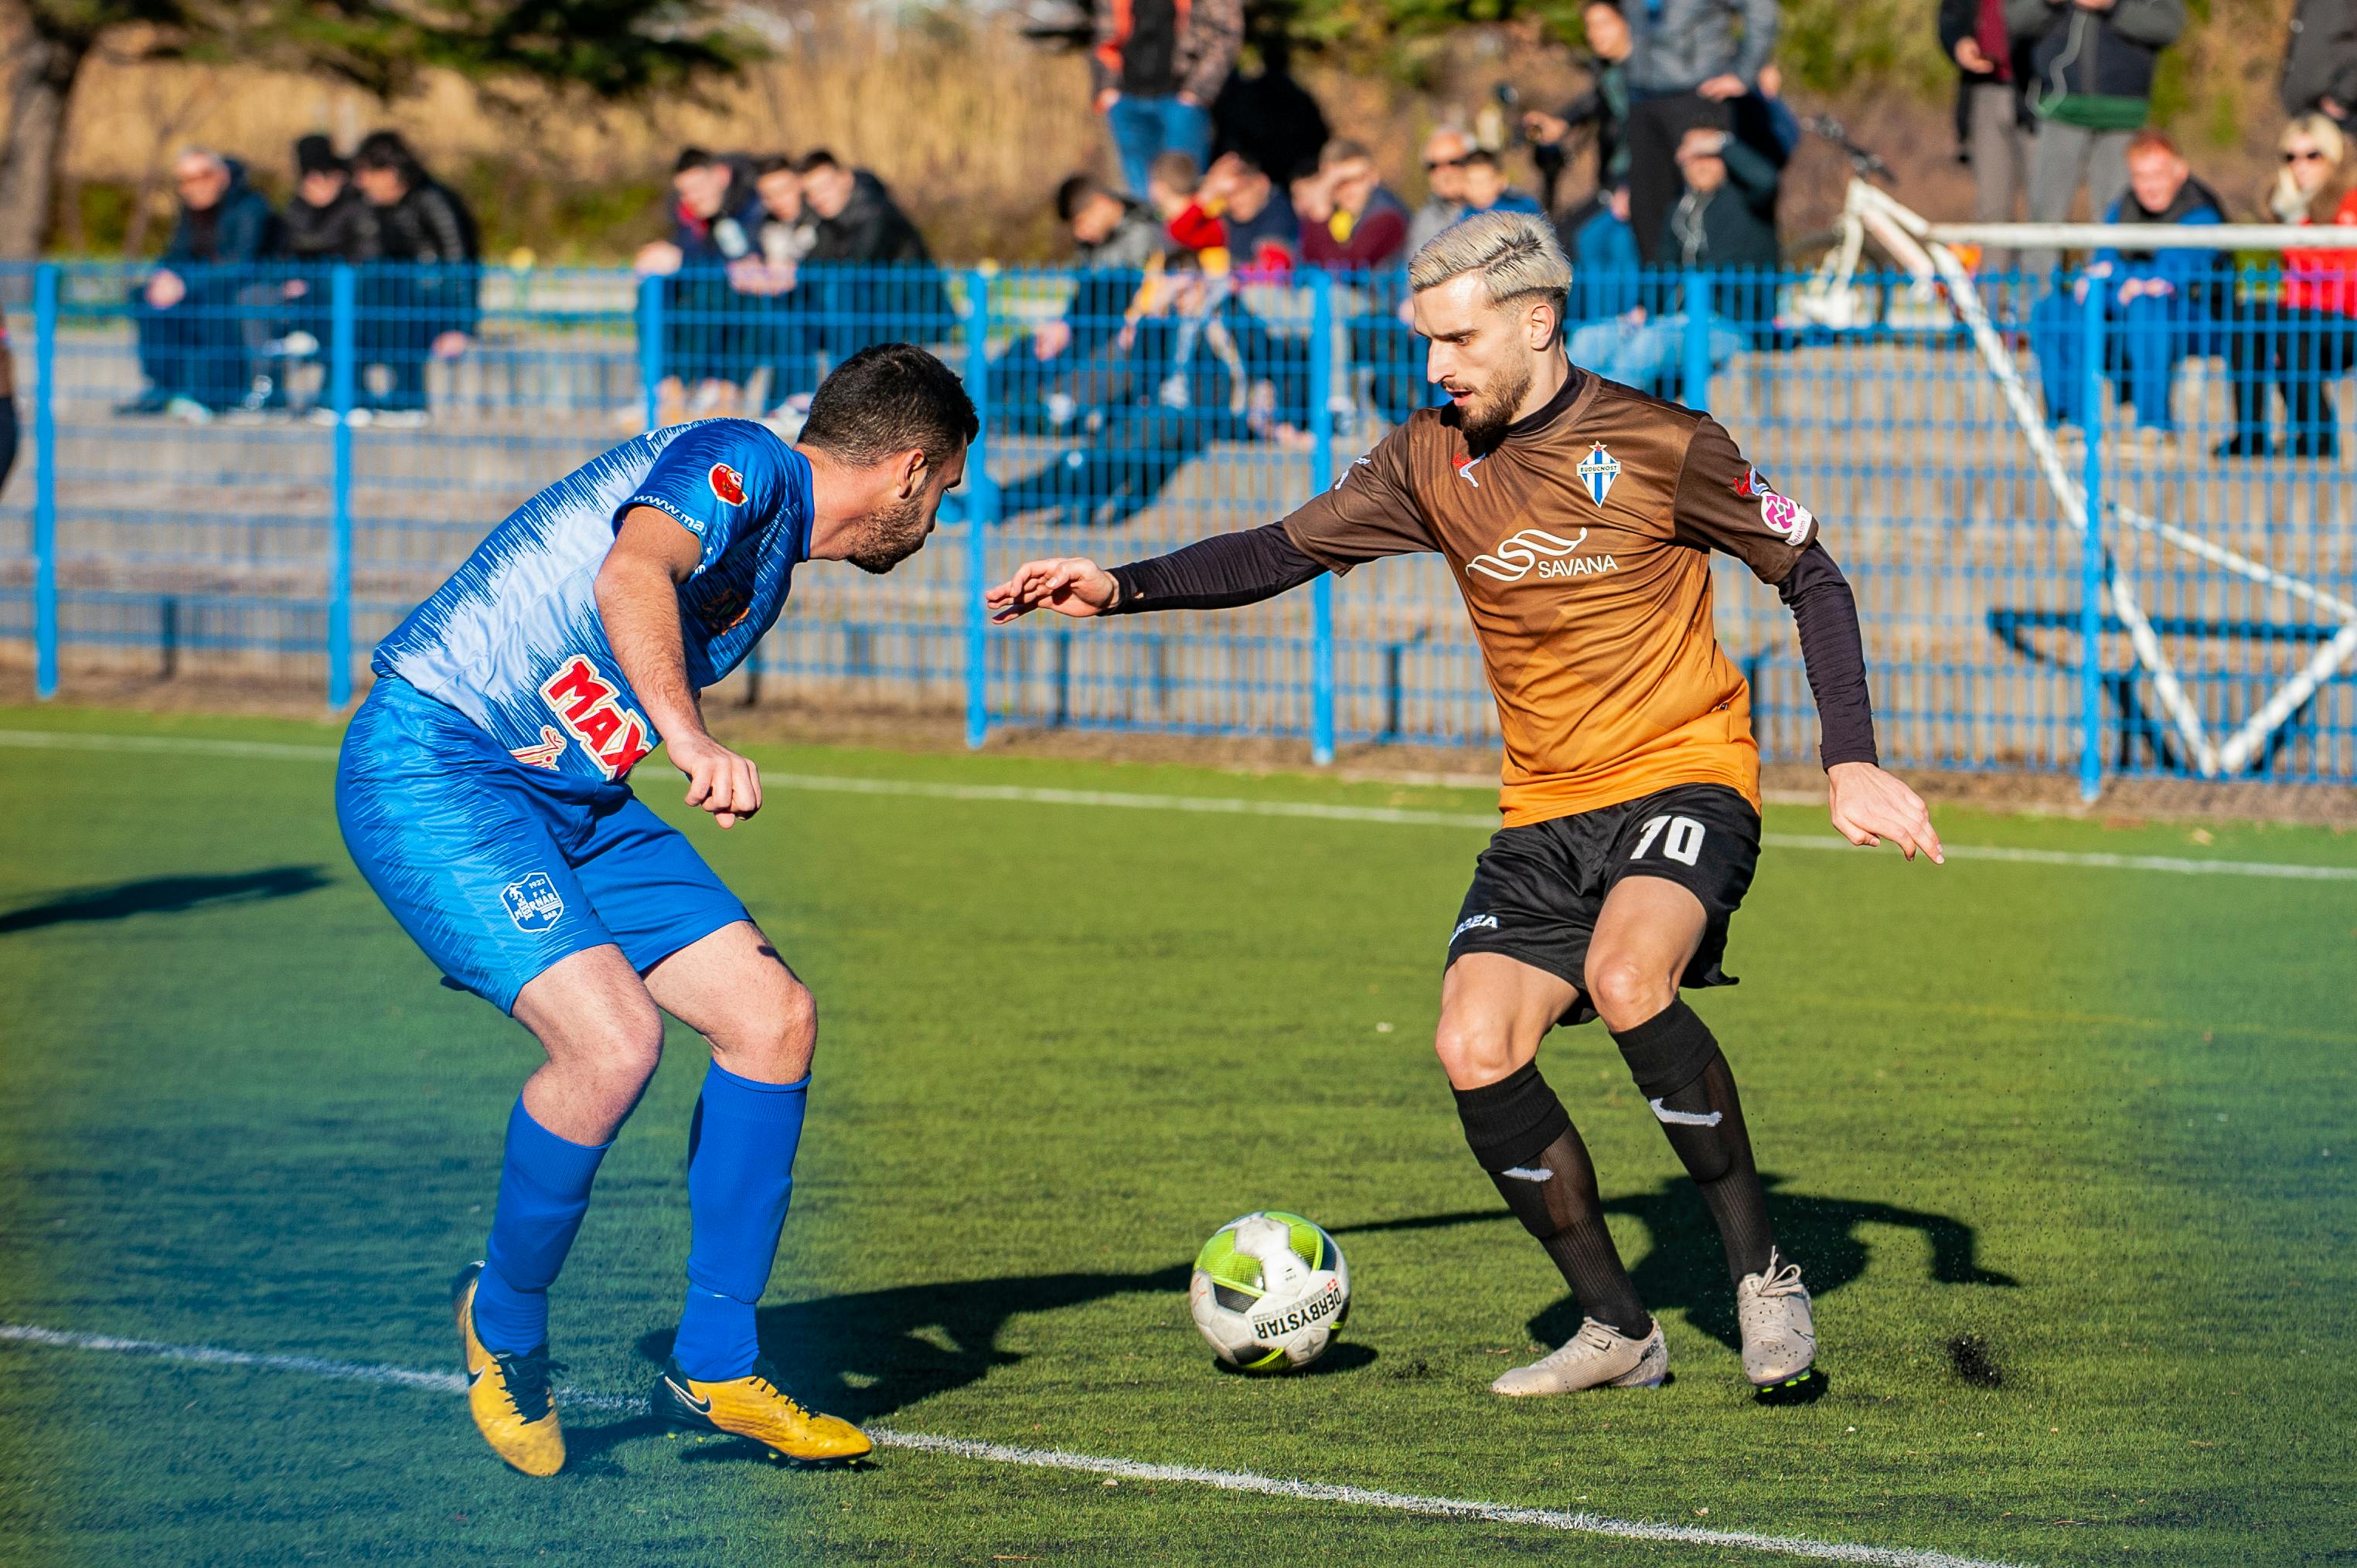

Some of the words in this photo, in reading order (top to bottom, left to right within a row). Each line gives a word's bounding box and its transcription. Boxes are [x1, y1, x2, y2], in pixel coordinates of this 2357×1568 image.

[1538, 554, 1618, 578] SAVANA
[543, 657, 651, 781] MAX
[1254, 1287, 1342, 1339] DERBYSTAR
